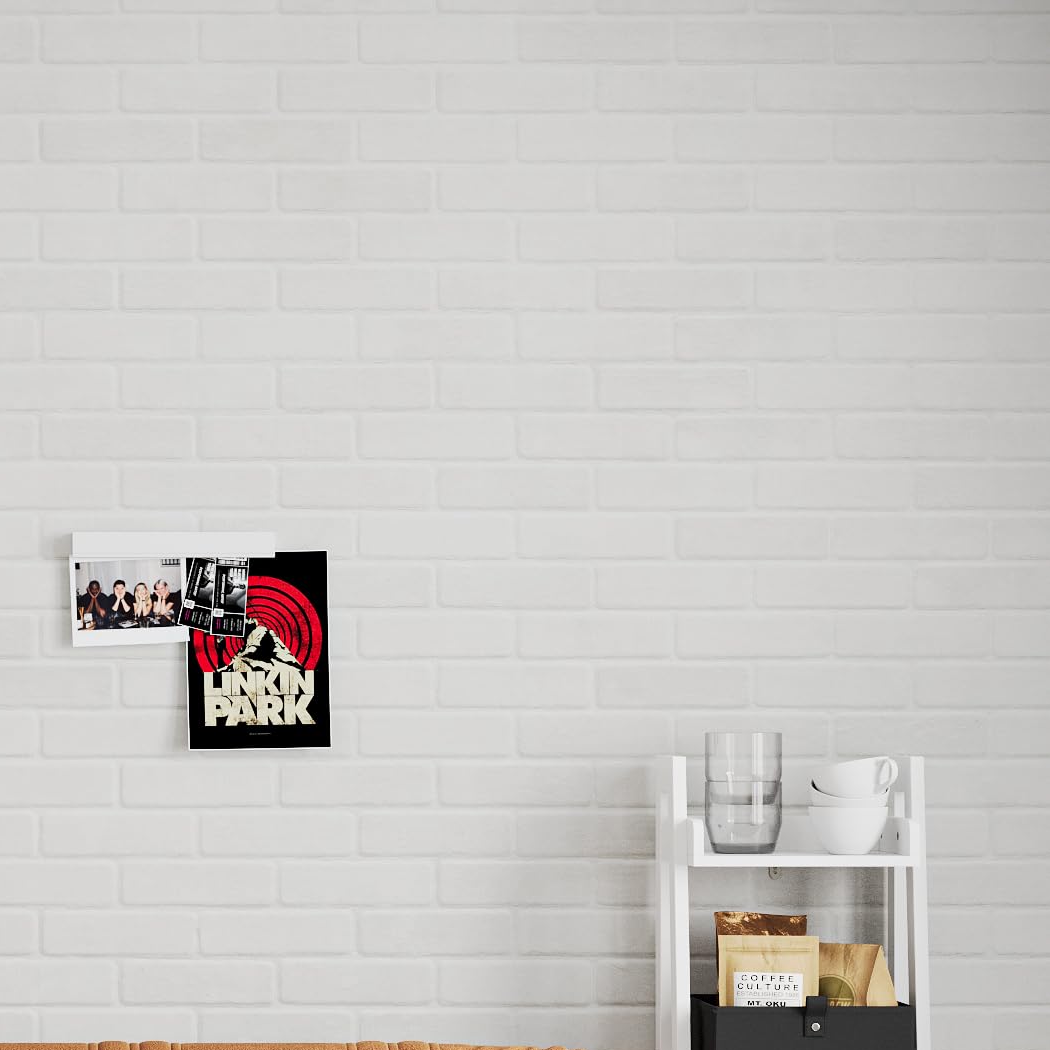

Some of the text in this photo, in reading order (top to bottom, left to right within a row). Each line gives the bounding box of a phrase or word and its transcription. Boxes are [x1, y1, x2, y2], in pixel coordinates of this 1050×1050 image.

[204, 670, 314, 696] LINKIN
[204, 694, 316, 726] PARK
[741, 974, 794, 982] COFFEE
[738, 983, 798, 991] CULTURE
